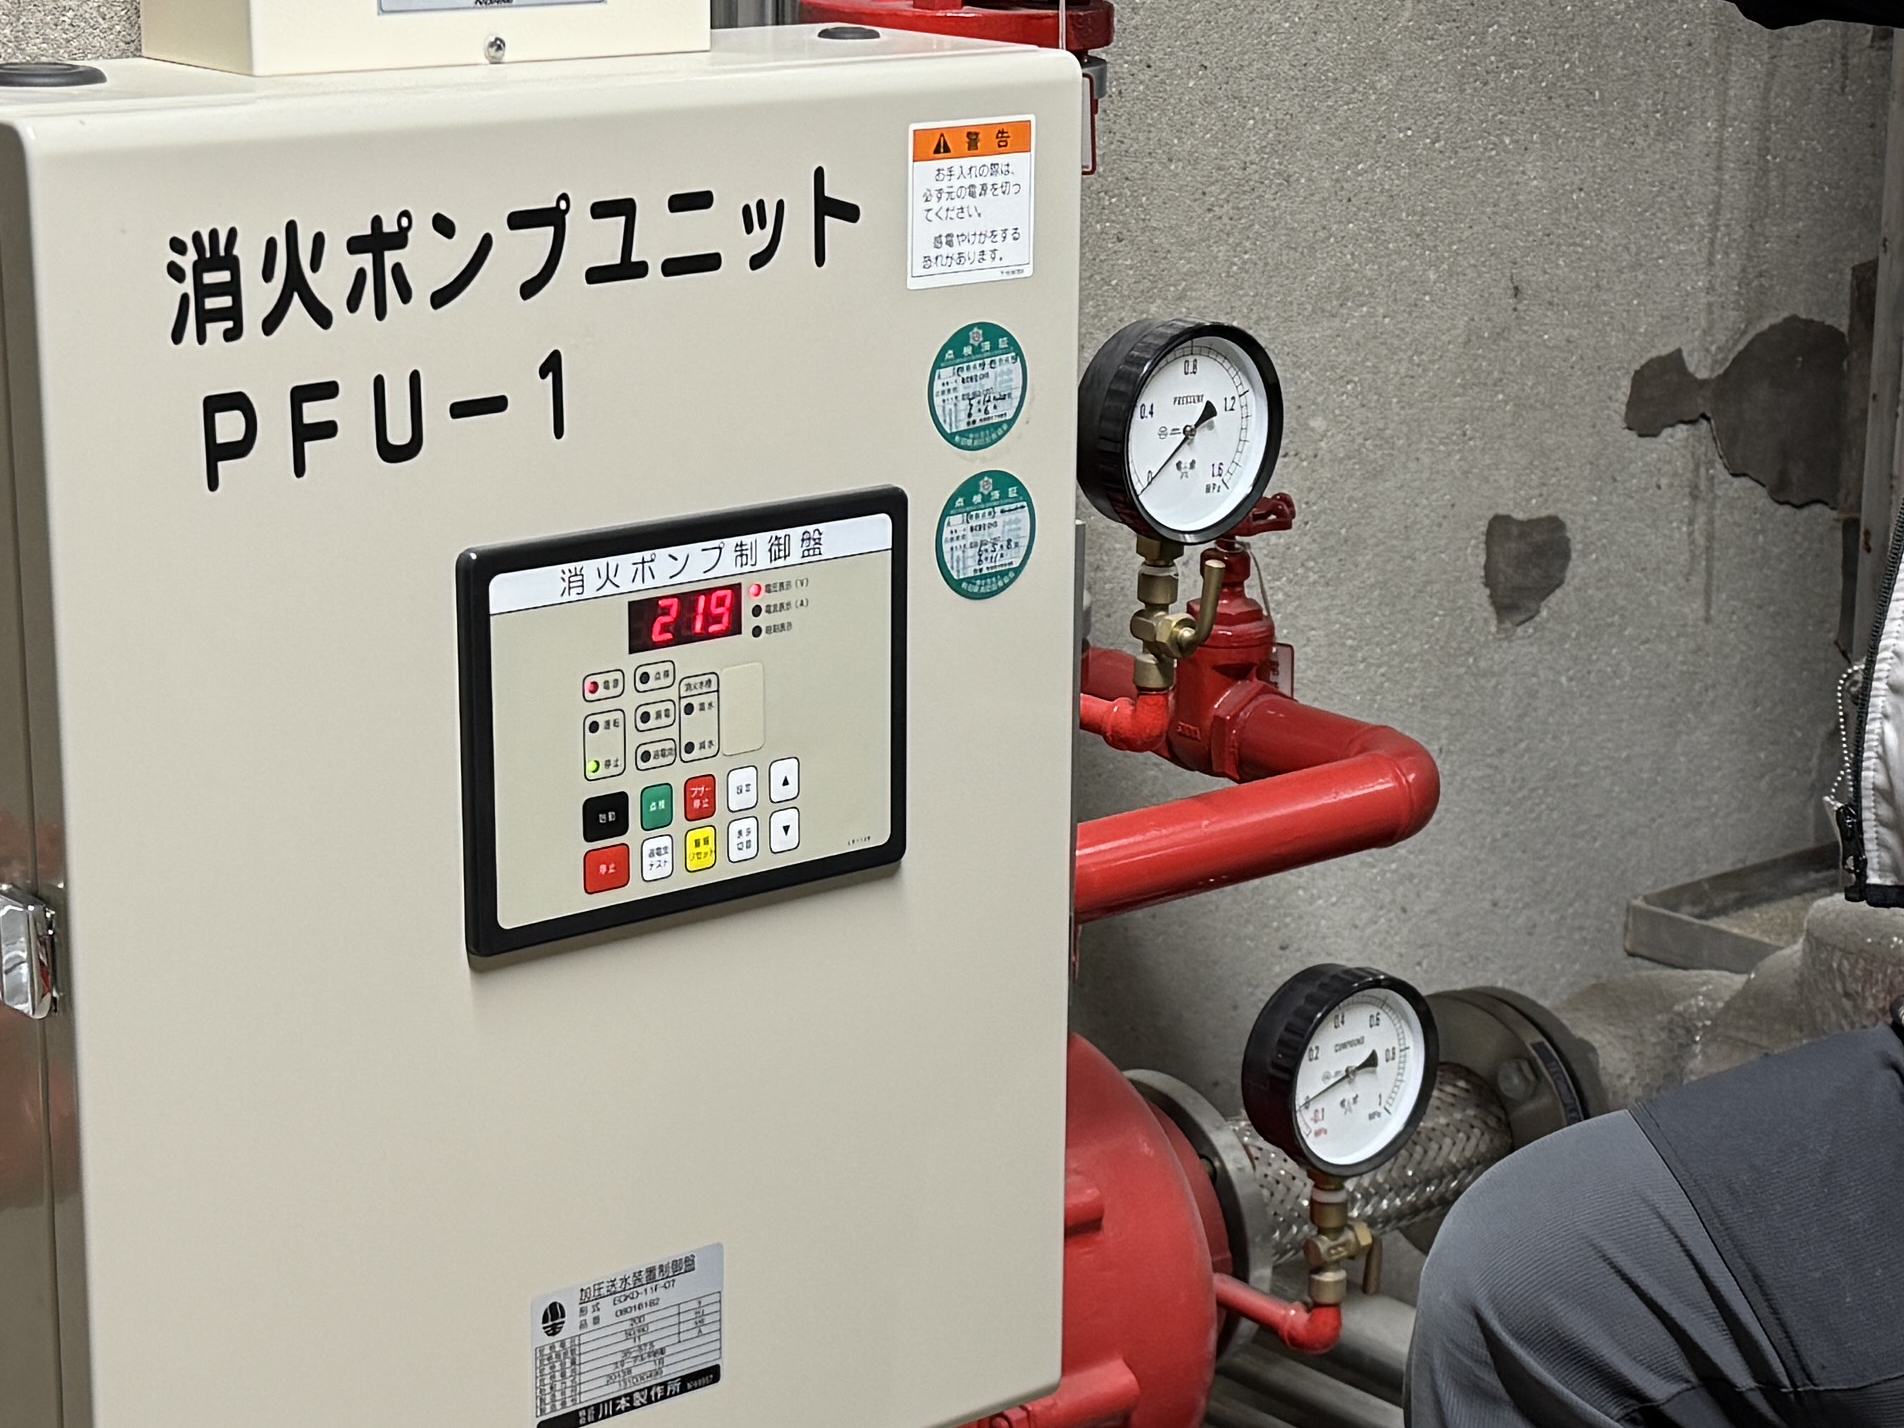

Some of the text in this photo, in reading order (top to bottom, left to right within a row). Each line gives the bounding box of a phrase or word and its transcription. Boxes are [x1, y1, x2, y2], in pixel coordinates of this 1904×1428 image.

[924, 205, 982, 223] てください。
[166, 165, 862, 347] 消火ポンプユニット
[1184, 359, 1198, 376] 0.8
[1139, 396, 1236, 420] 0.4 1.2
[1211, 462, 1224, 478] 1.6
[559, 527, 826, 598] 消火ポンプ制御盤
[651, 589, 734, 643] 219
[1308, 1046, 1320, 1062] 0.2
[579, 1253, 696, 1302] 加圧送水装置制御盤
[597, 1378, 682, 1420] 川本製作所
